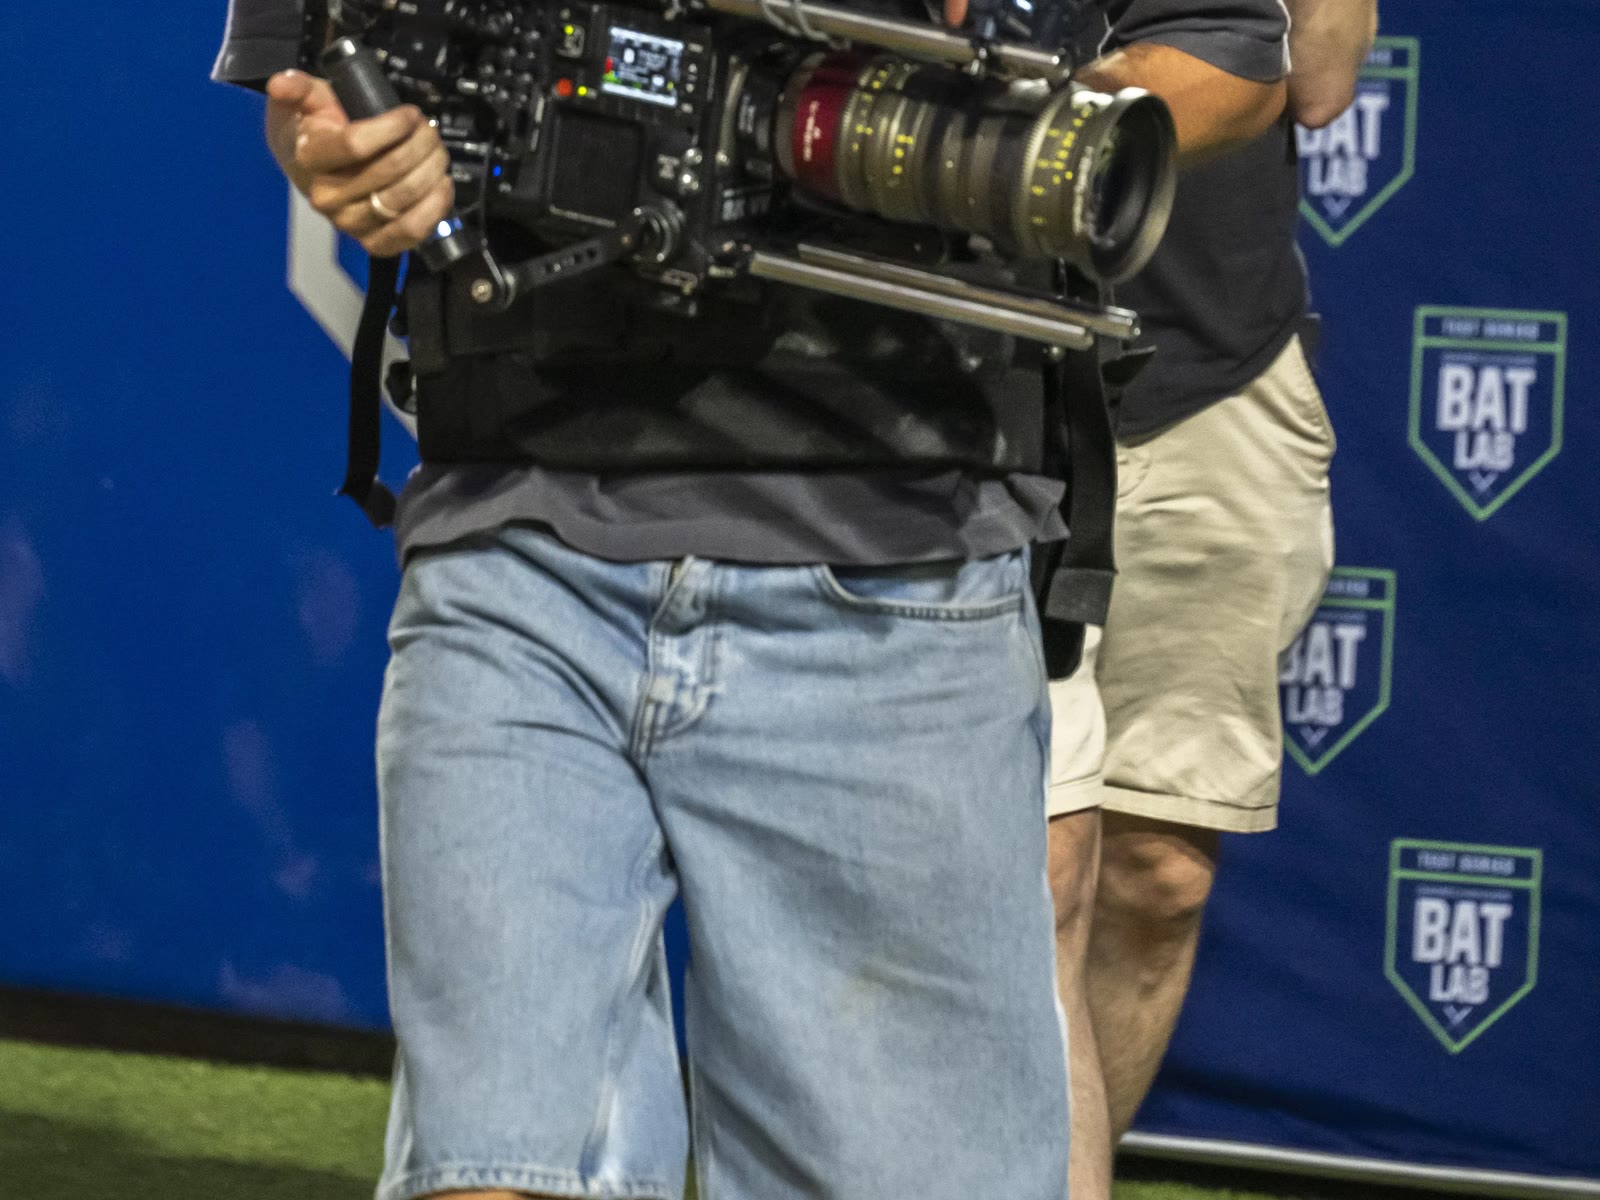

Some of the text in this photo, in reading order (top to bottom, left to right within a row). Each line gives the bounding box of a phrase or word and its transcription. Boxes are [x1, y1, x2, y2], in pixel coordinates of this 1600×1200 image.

[1435, 363, 1537, 435] BAT
[1453, 429, 1515, 473] LAB
[1286, 683, 1343, 726] LAB
[1412, 897, 1513, 969] BAT
[1428, 961, 1490, 1005] LAB
